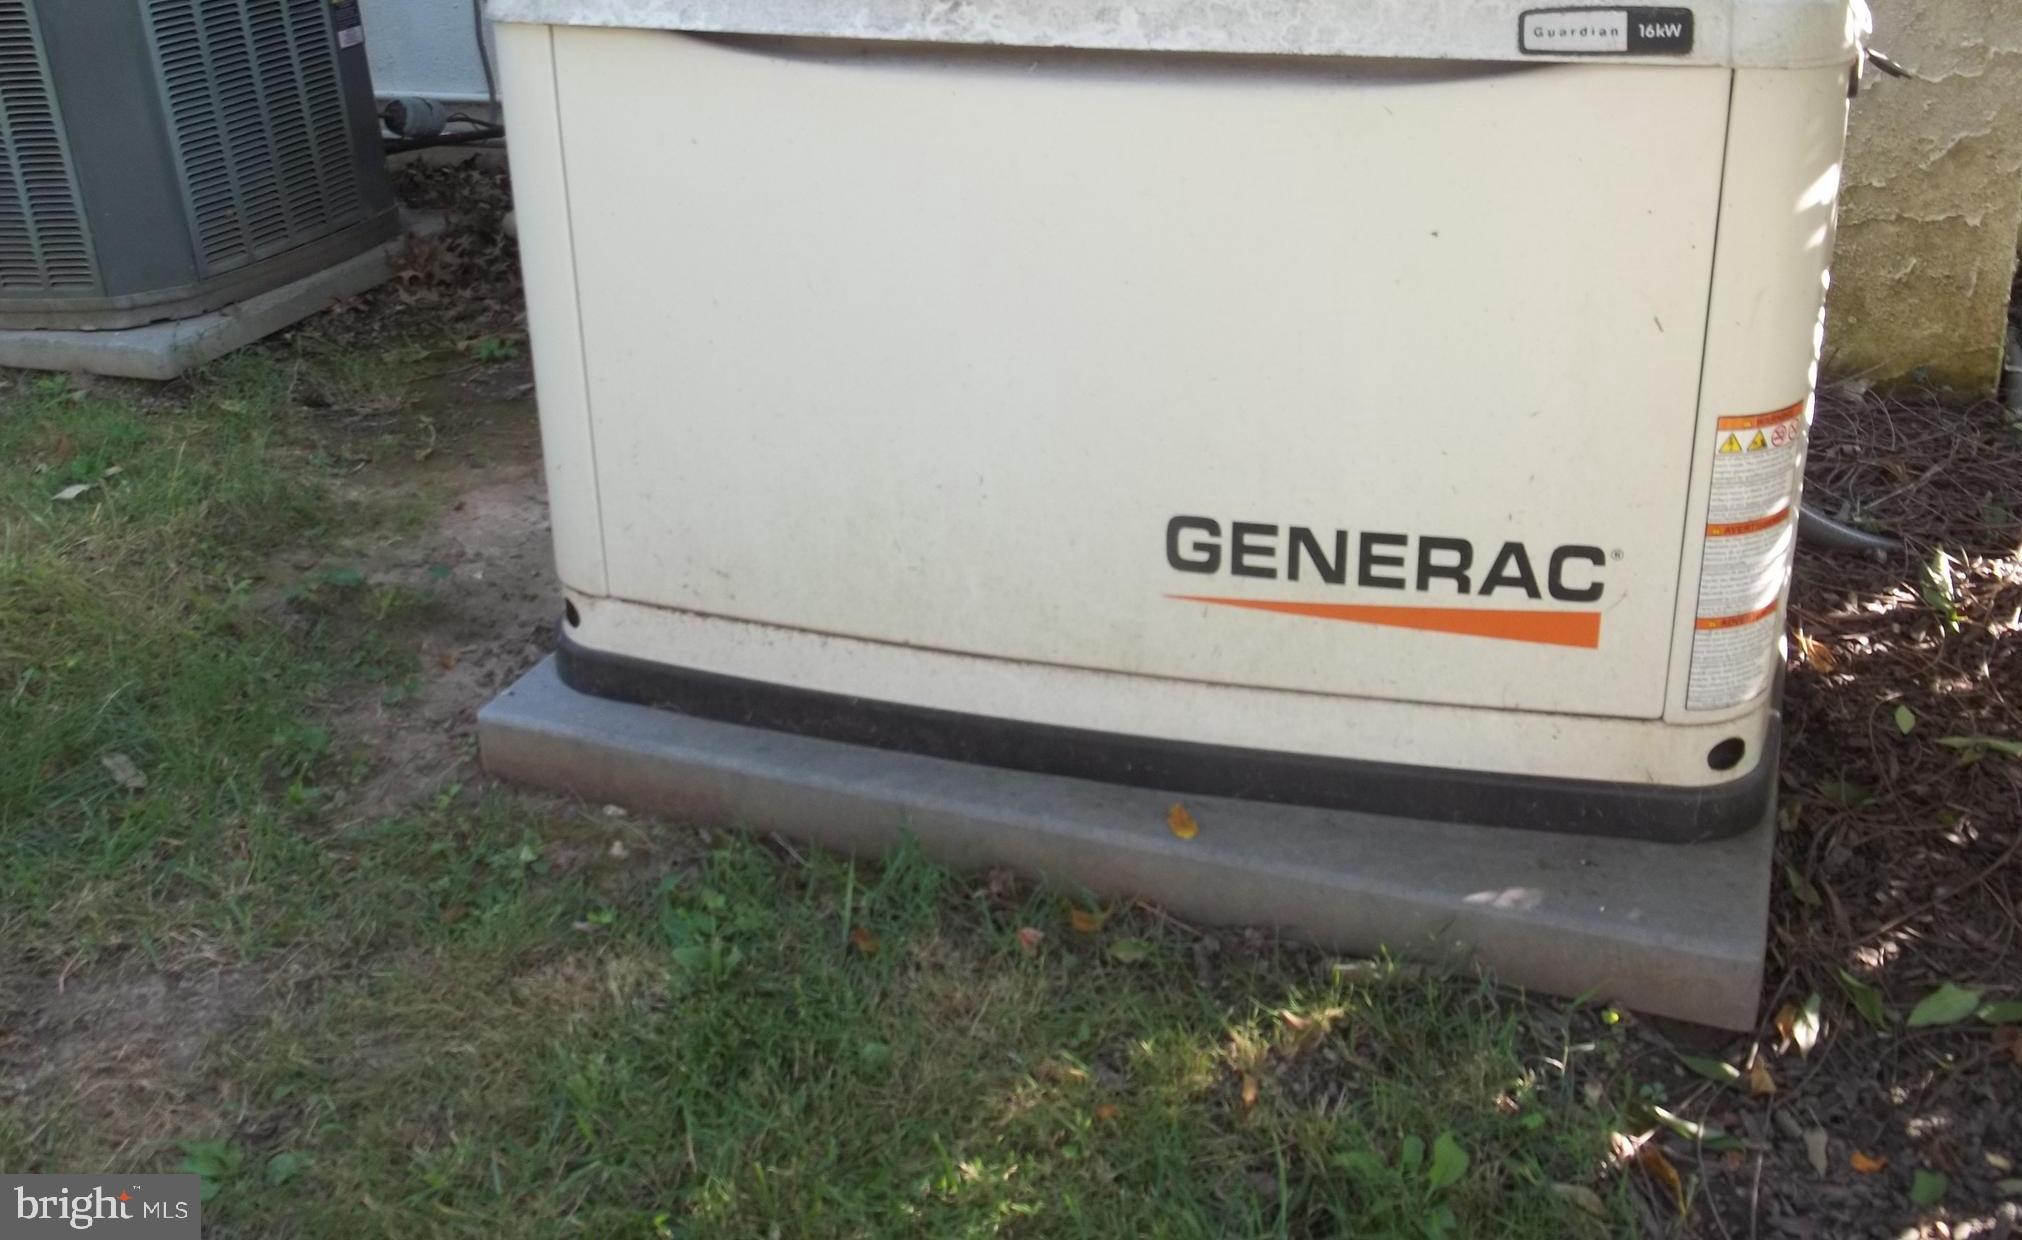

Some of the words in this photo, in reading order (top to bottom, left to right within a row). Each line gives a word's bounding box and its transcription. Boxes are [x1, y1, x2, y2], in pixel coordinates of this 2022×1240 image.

[1533, 26, 1619, 38] Guardian
[1638, 23, 1682, 38] 16kW
[1166, 515, 1607, 602] GENERAC
